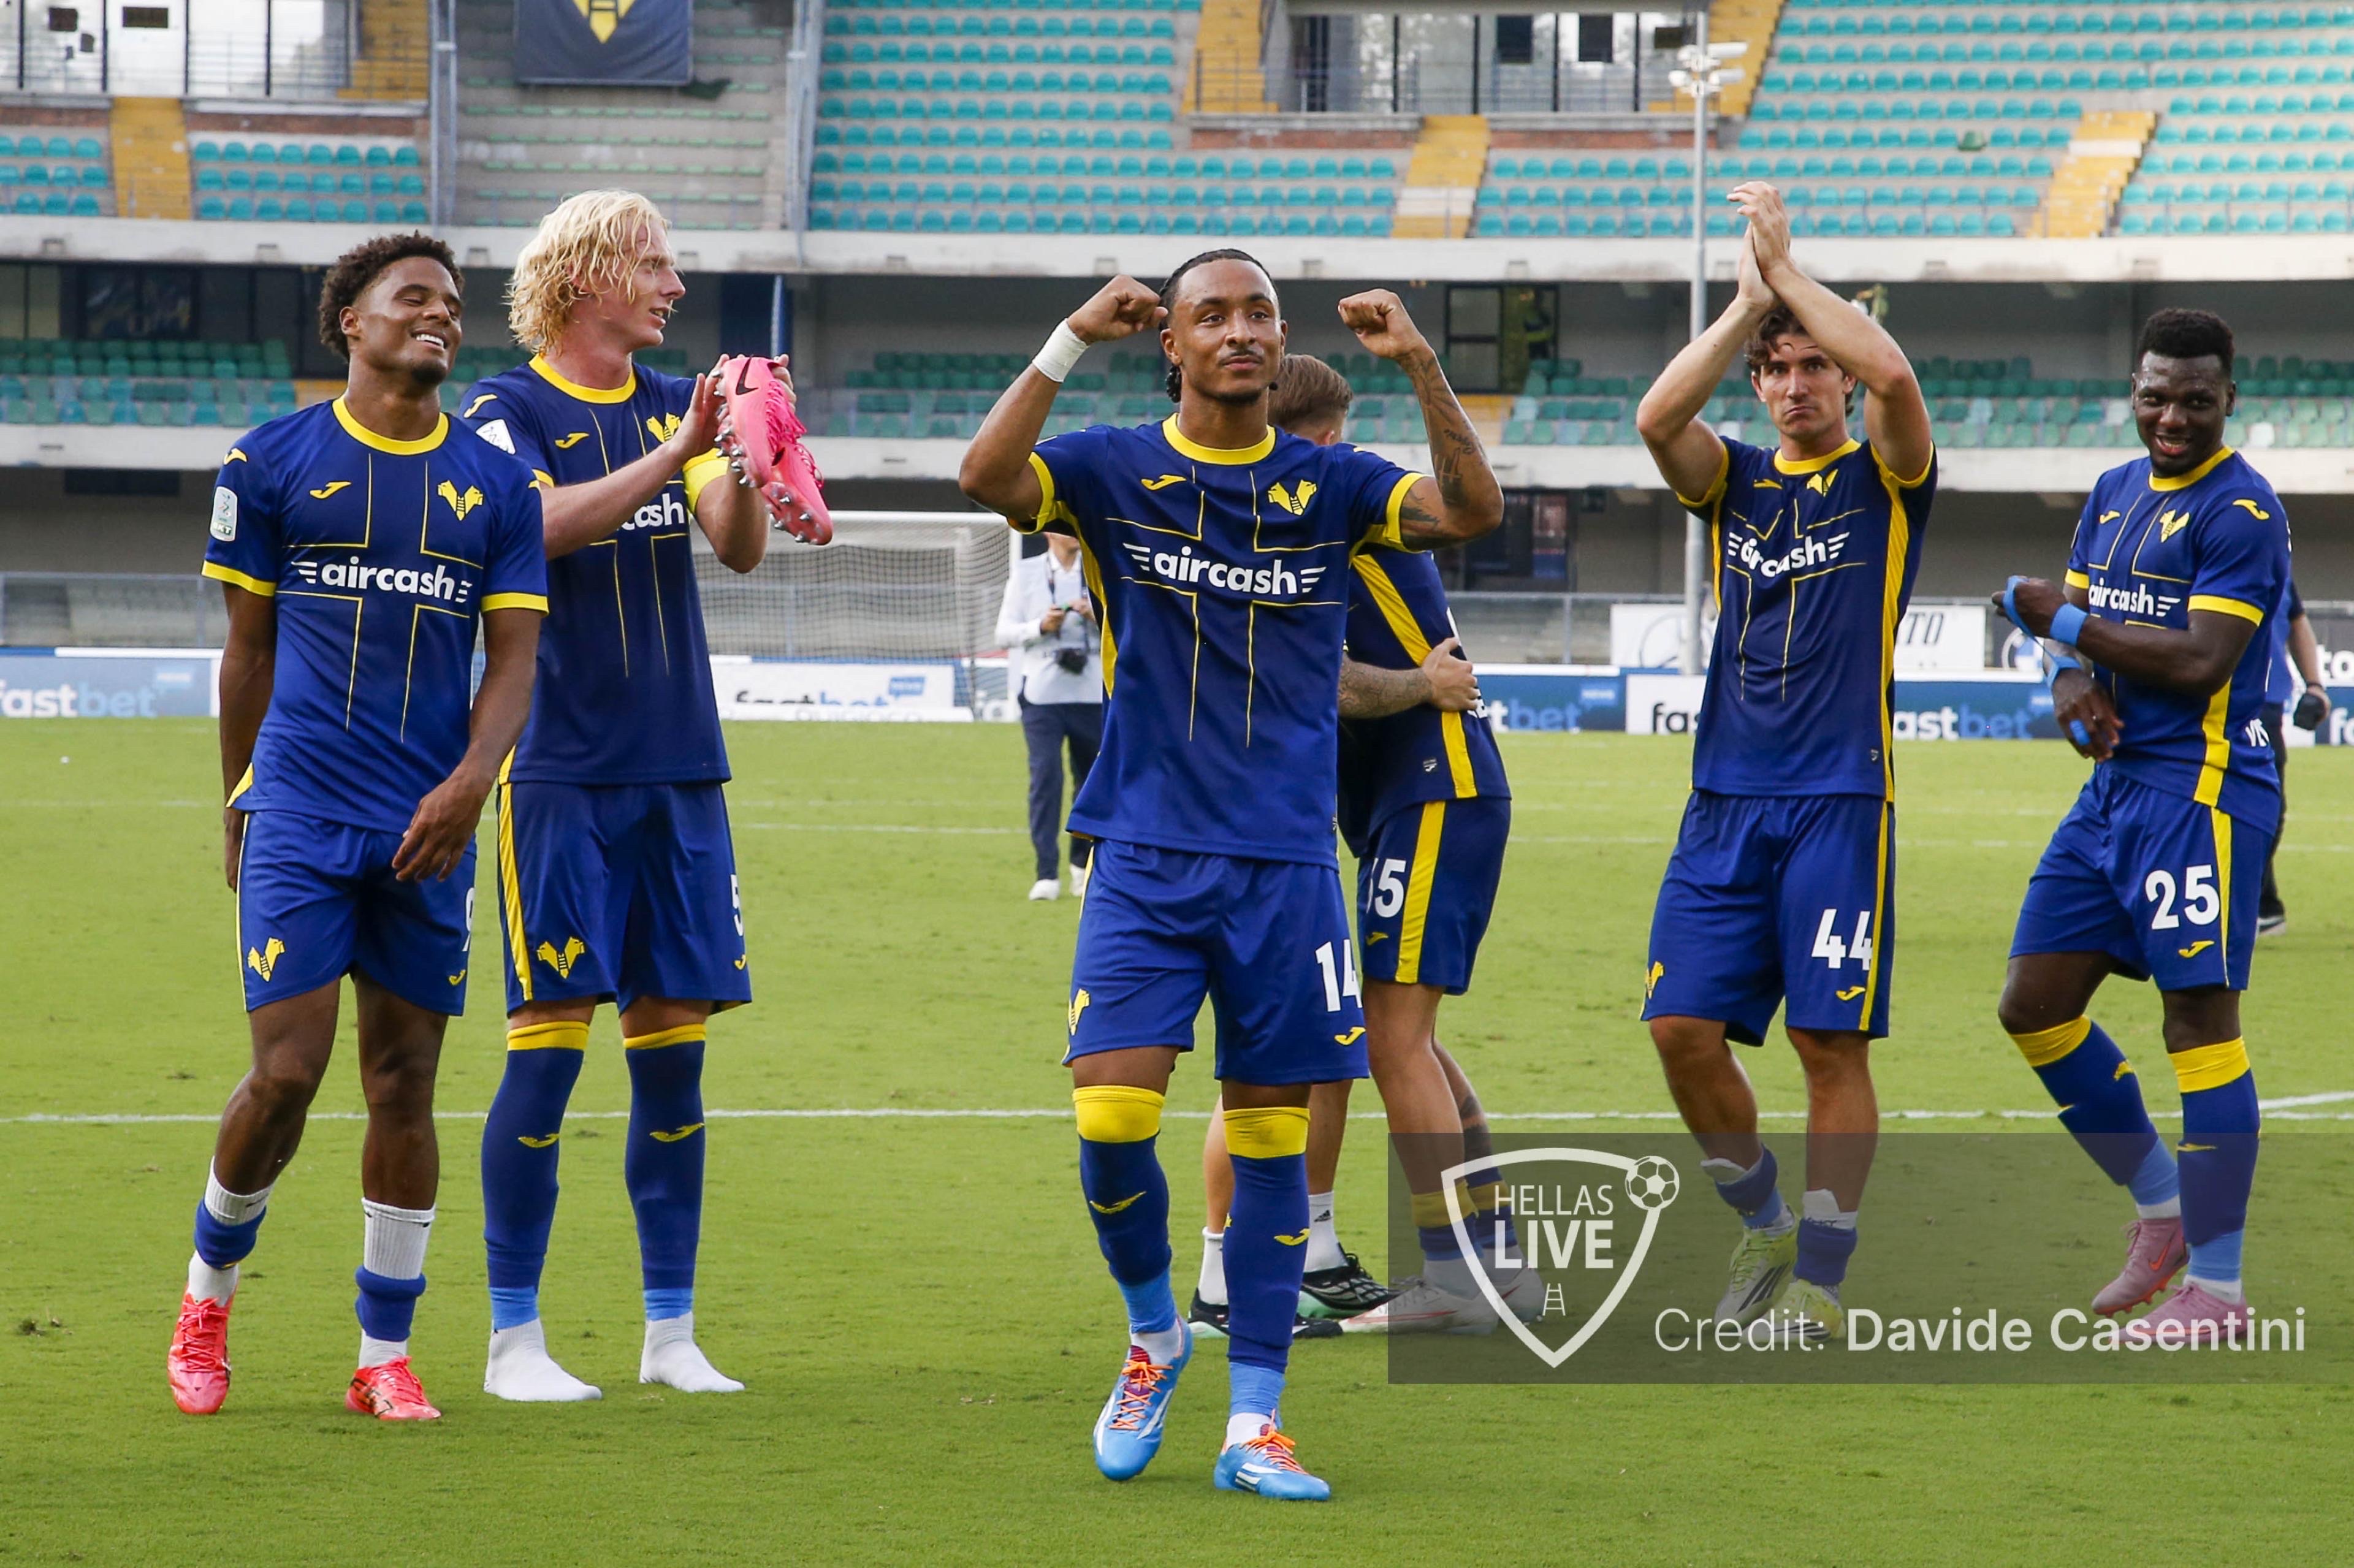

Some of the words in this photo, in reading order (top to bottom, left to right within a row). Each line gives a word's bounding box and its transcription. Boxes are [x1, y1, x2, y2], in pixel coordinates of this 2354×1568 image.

[321, 556, 455, 601] aircash
[1154, 546, 1297, 595] aircash
[2089, 577, 2154, 615] aircash
[1366, 858, 1406, 918] 5
[2146, 864, 2219, 929] 25
[1811, 908, 1872, 970] 44
[1316, 939, 1362, 1011] 14
